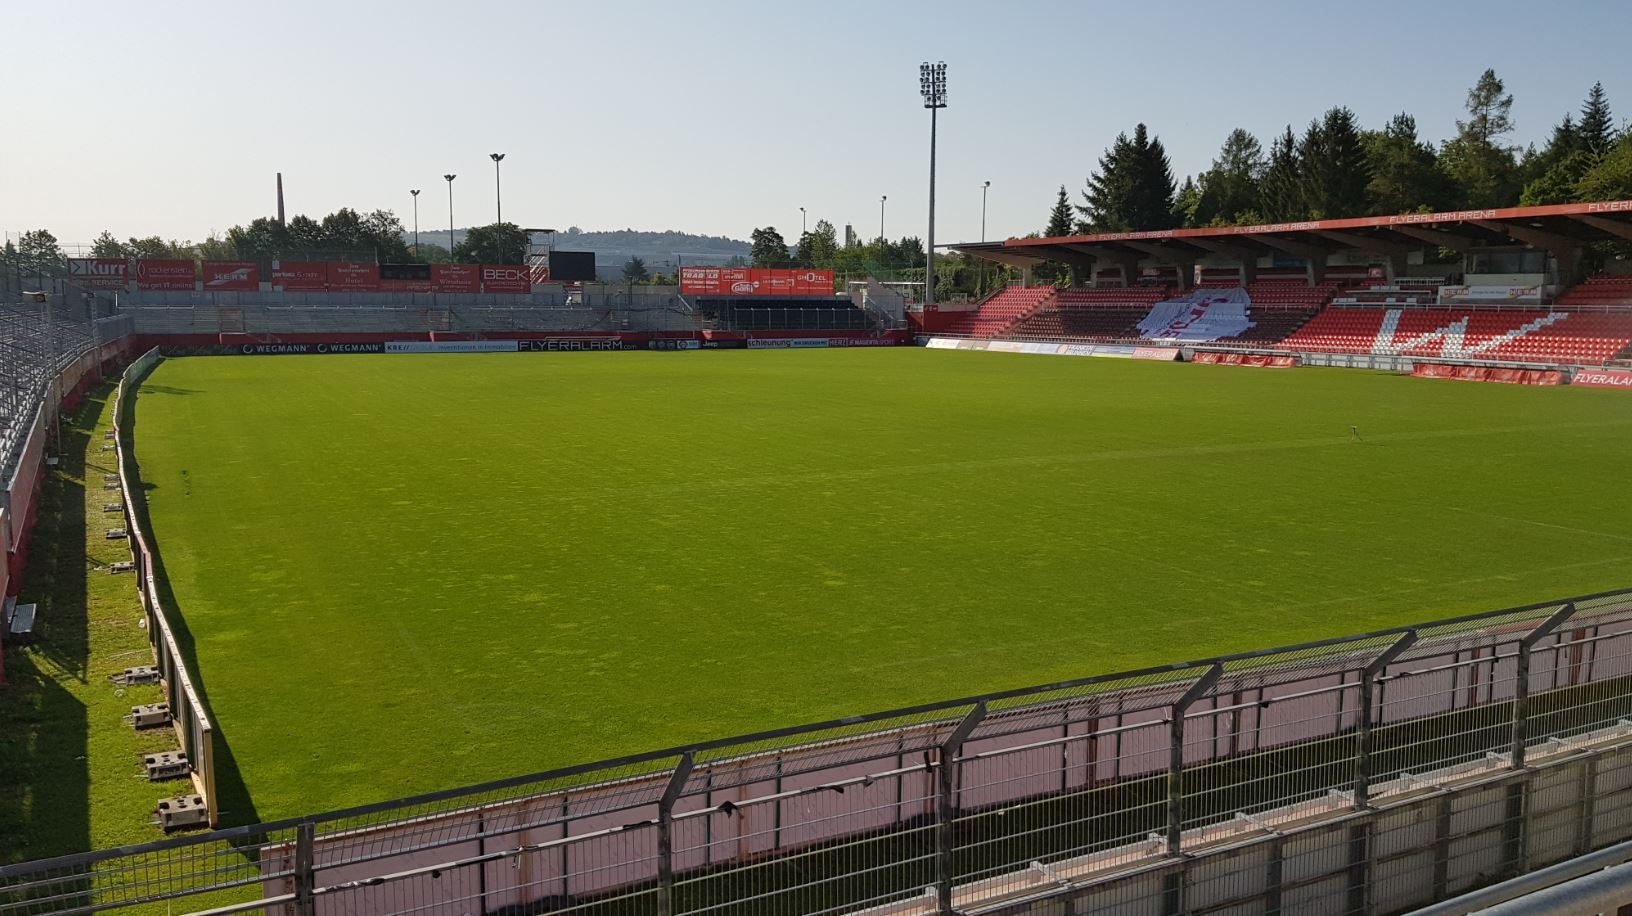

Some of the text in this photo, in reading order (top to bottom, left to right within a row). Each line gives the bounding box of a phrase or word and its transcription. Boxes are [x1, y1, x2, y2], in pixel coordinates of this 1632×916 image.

[1588, 200, 1632, 212] FLYER
[1389, 210, 1496, 223] FLYERALARM ARENA
[1233, 221, 1320, 233] FLYERALARM ARENA
[88, 260, 126, 275] Kurr
[484, 269, 530, 281] BECK
[256, 344, 306, 353] WEGMANN
[330, 344, 380, 352] WEGMANN
